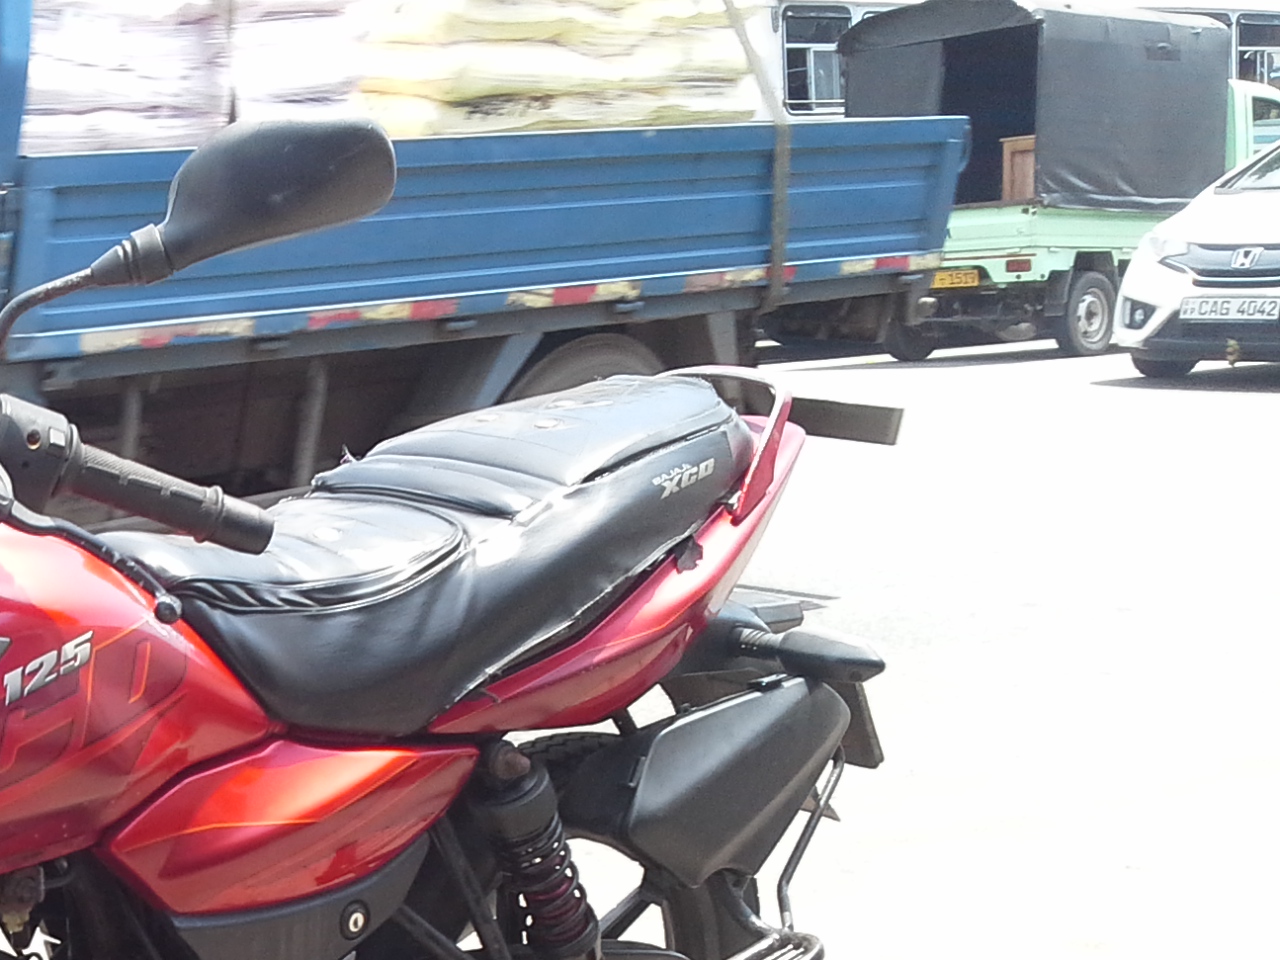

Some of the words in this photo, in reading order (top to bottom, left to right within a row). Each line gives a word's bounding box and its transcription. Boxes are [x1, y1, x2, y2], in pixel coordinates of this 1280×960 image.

[1198, 300, 1231, 316] CAG
[1236, 300, 1278, 316] 4042
[652, 463, 694, 486] BAJAJ
[660, 458, 715, 499] XCD
[3, 630, 94, 706] 125
